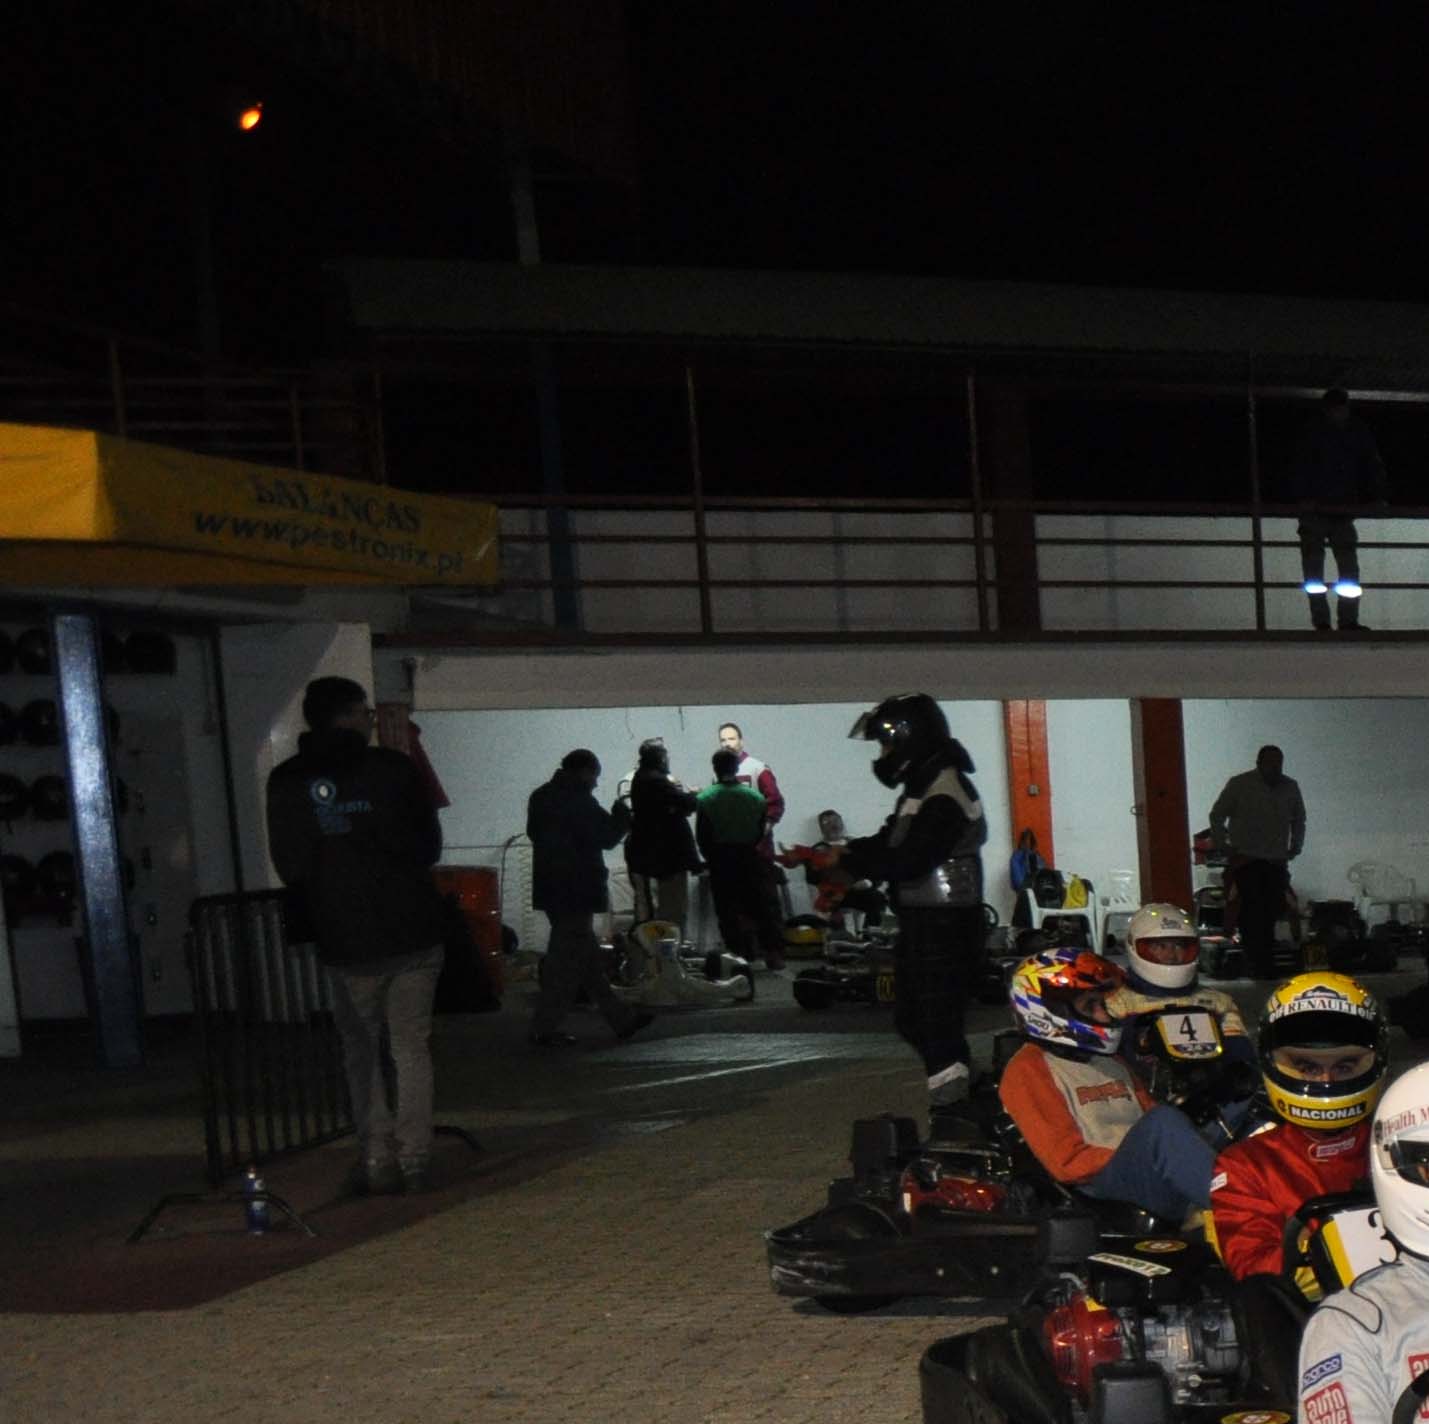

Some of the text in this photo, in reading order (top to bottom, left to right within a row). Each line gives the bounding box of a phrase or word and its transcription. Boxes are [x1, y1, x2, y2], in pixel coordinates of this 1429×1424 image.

[1286, 998, 1353, 1014] RENAULT
[1179, 1015, 1197, 1042] 4
[1290, 1102, 1363, 1121] NACIONAL
[1306, 1388, 1345, 1420] auto
